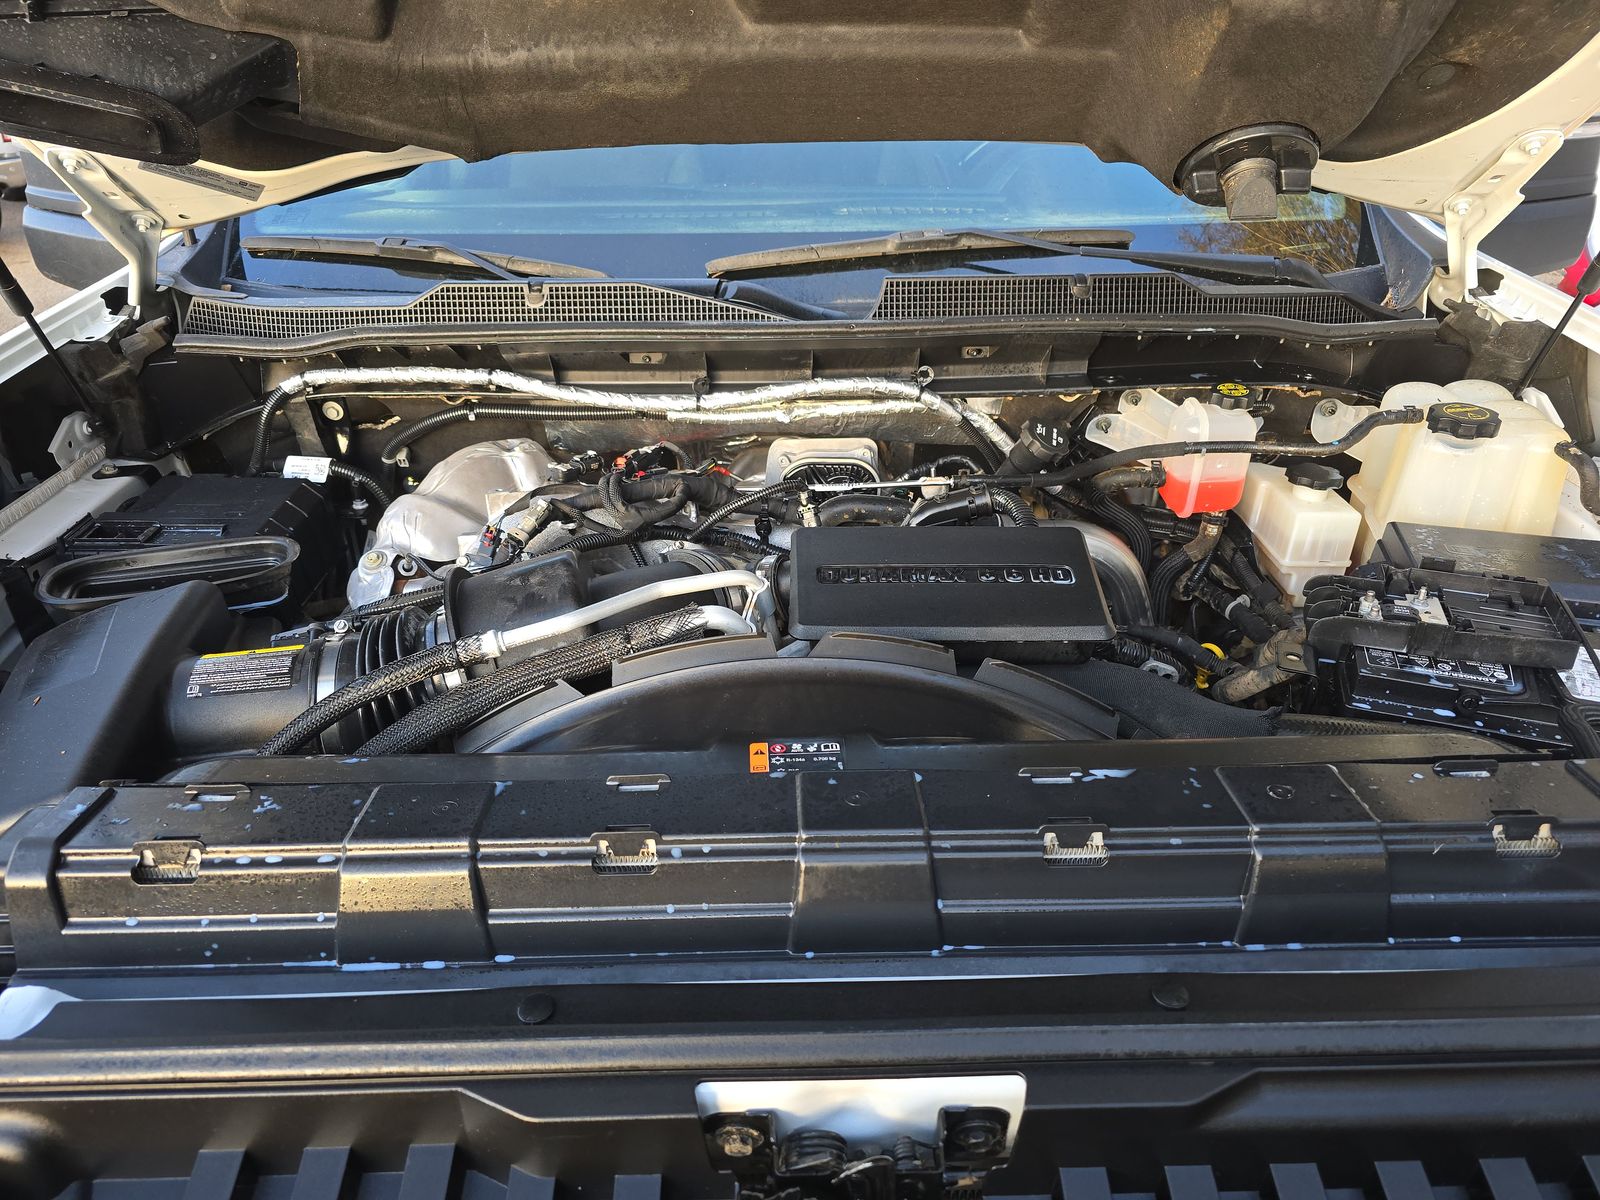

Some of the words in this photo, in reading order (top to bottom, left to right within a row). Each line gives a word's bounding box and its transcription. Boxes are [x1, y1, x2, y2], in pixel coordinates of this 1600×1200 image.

[817, 566, 967, 584] DURAMAX
[977, 566, 1025, 584] 6.6
[1029, 566, 1076, 585] HD
